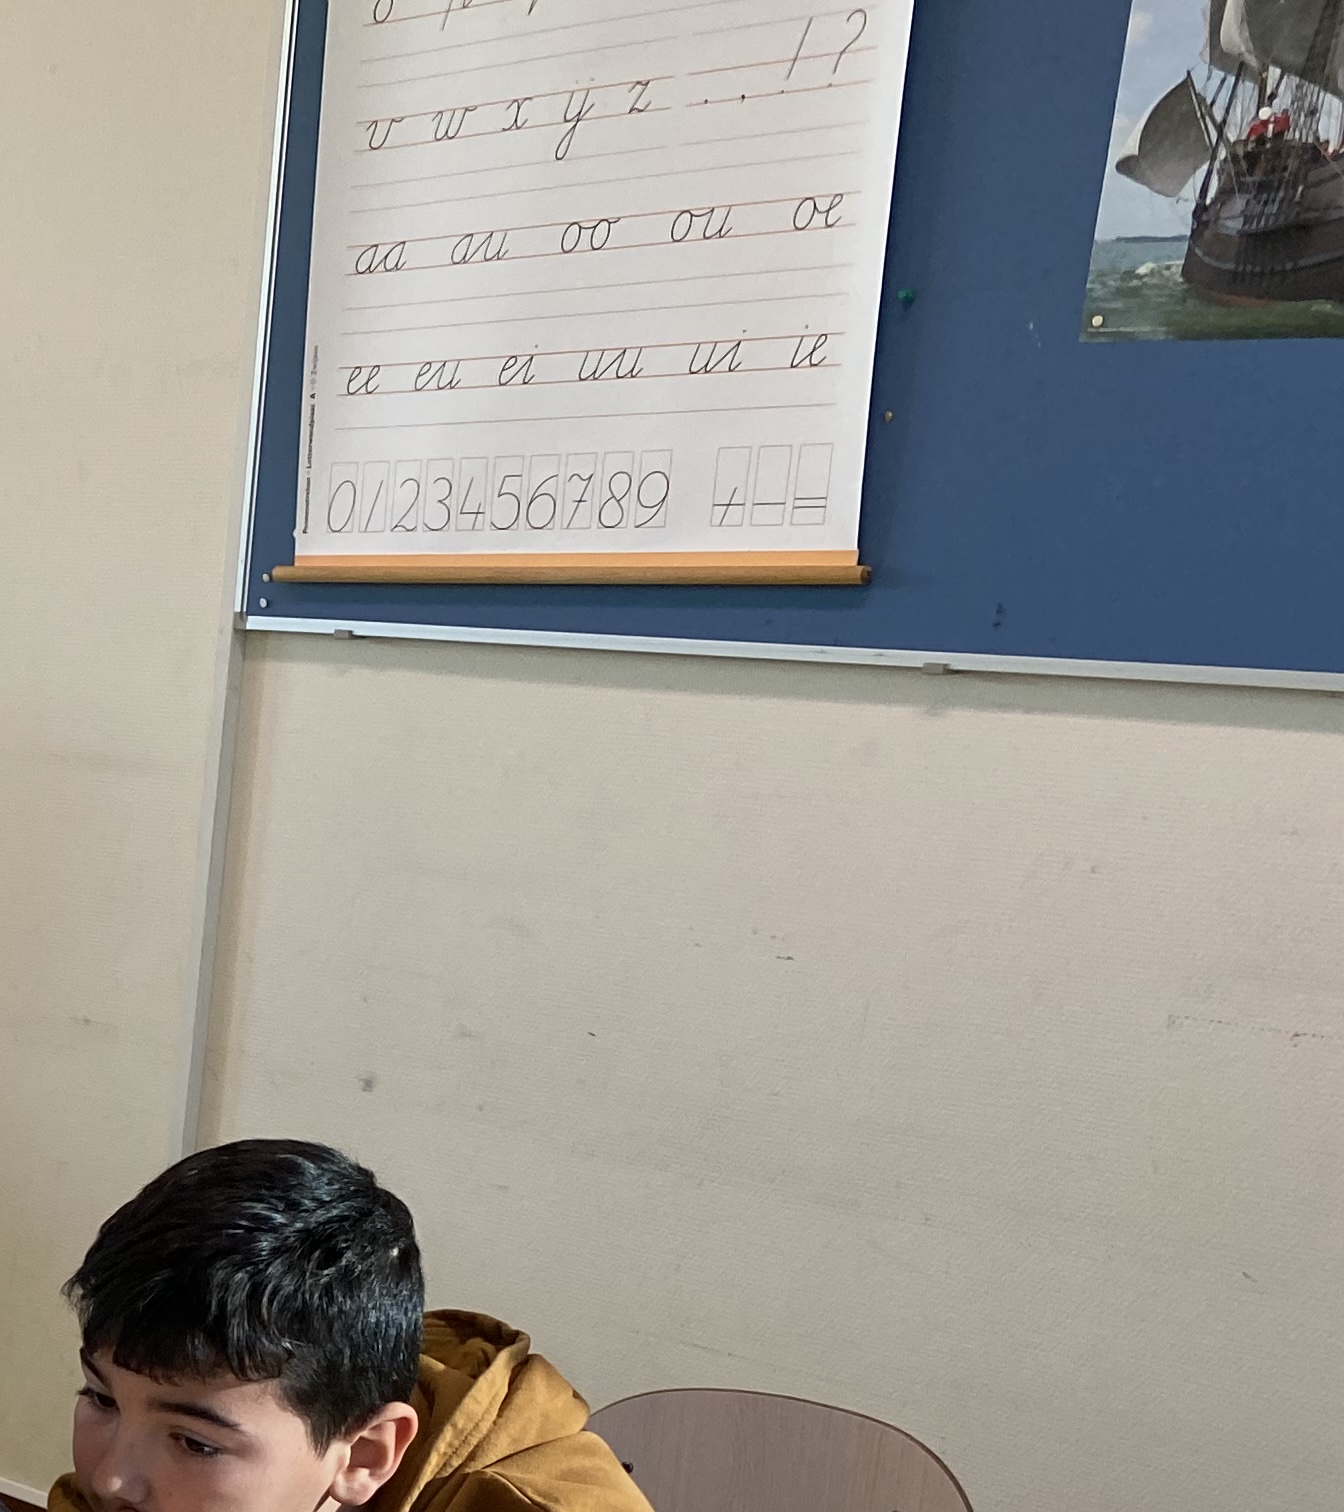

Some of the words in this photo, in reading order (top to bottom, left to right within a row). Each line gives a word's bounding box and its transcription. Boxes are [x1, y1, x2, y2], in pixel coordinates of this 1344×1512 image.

[365, 116, 406, 150] v
[431, 105, 478, 141] w
[502, 97, 533, 131] x
[627, 80, 653, 114] z
[826, 8, 867, 88] ?
[355, 240, 407, 275] aa
[450, 230, 510, 265] au
[560, 217, 621, 254] oo
[670, 206, 733, 243] ou
[792, 193, 844, 231] oe
[346, 364, 382, 395] ee
[414, 359, 462, 392] eu
[498, 343, 536, 387] ei
[578, 347, 644, 381] uu
[688, 328, 747, 375] ui
[790, 324, 828, 369] ie
